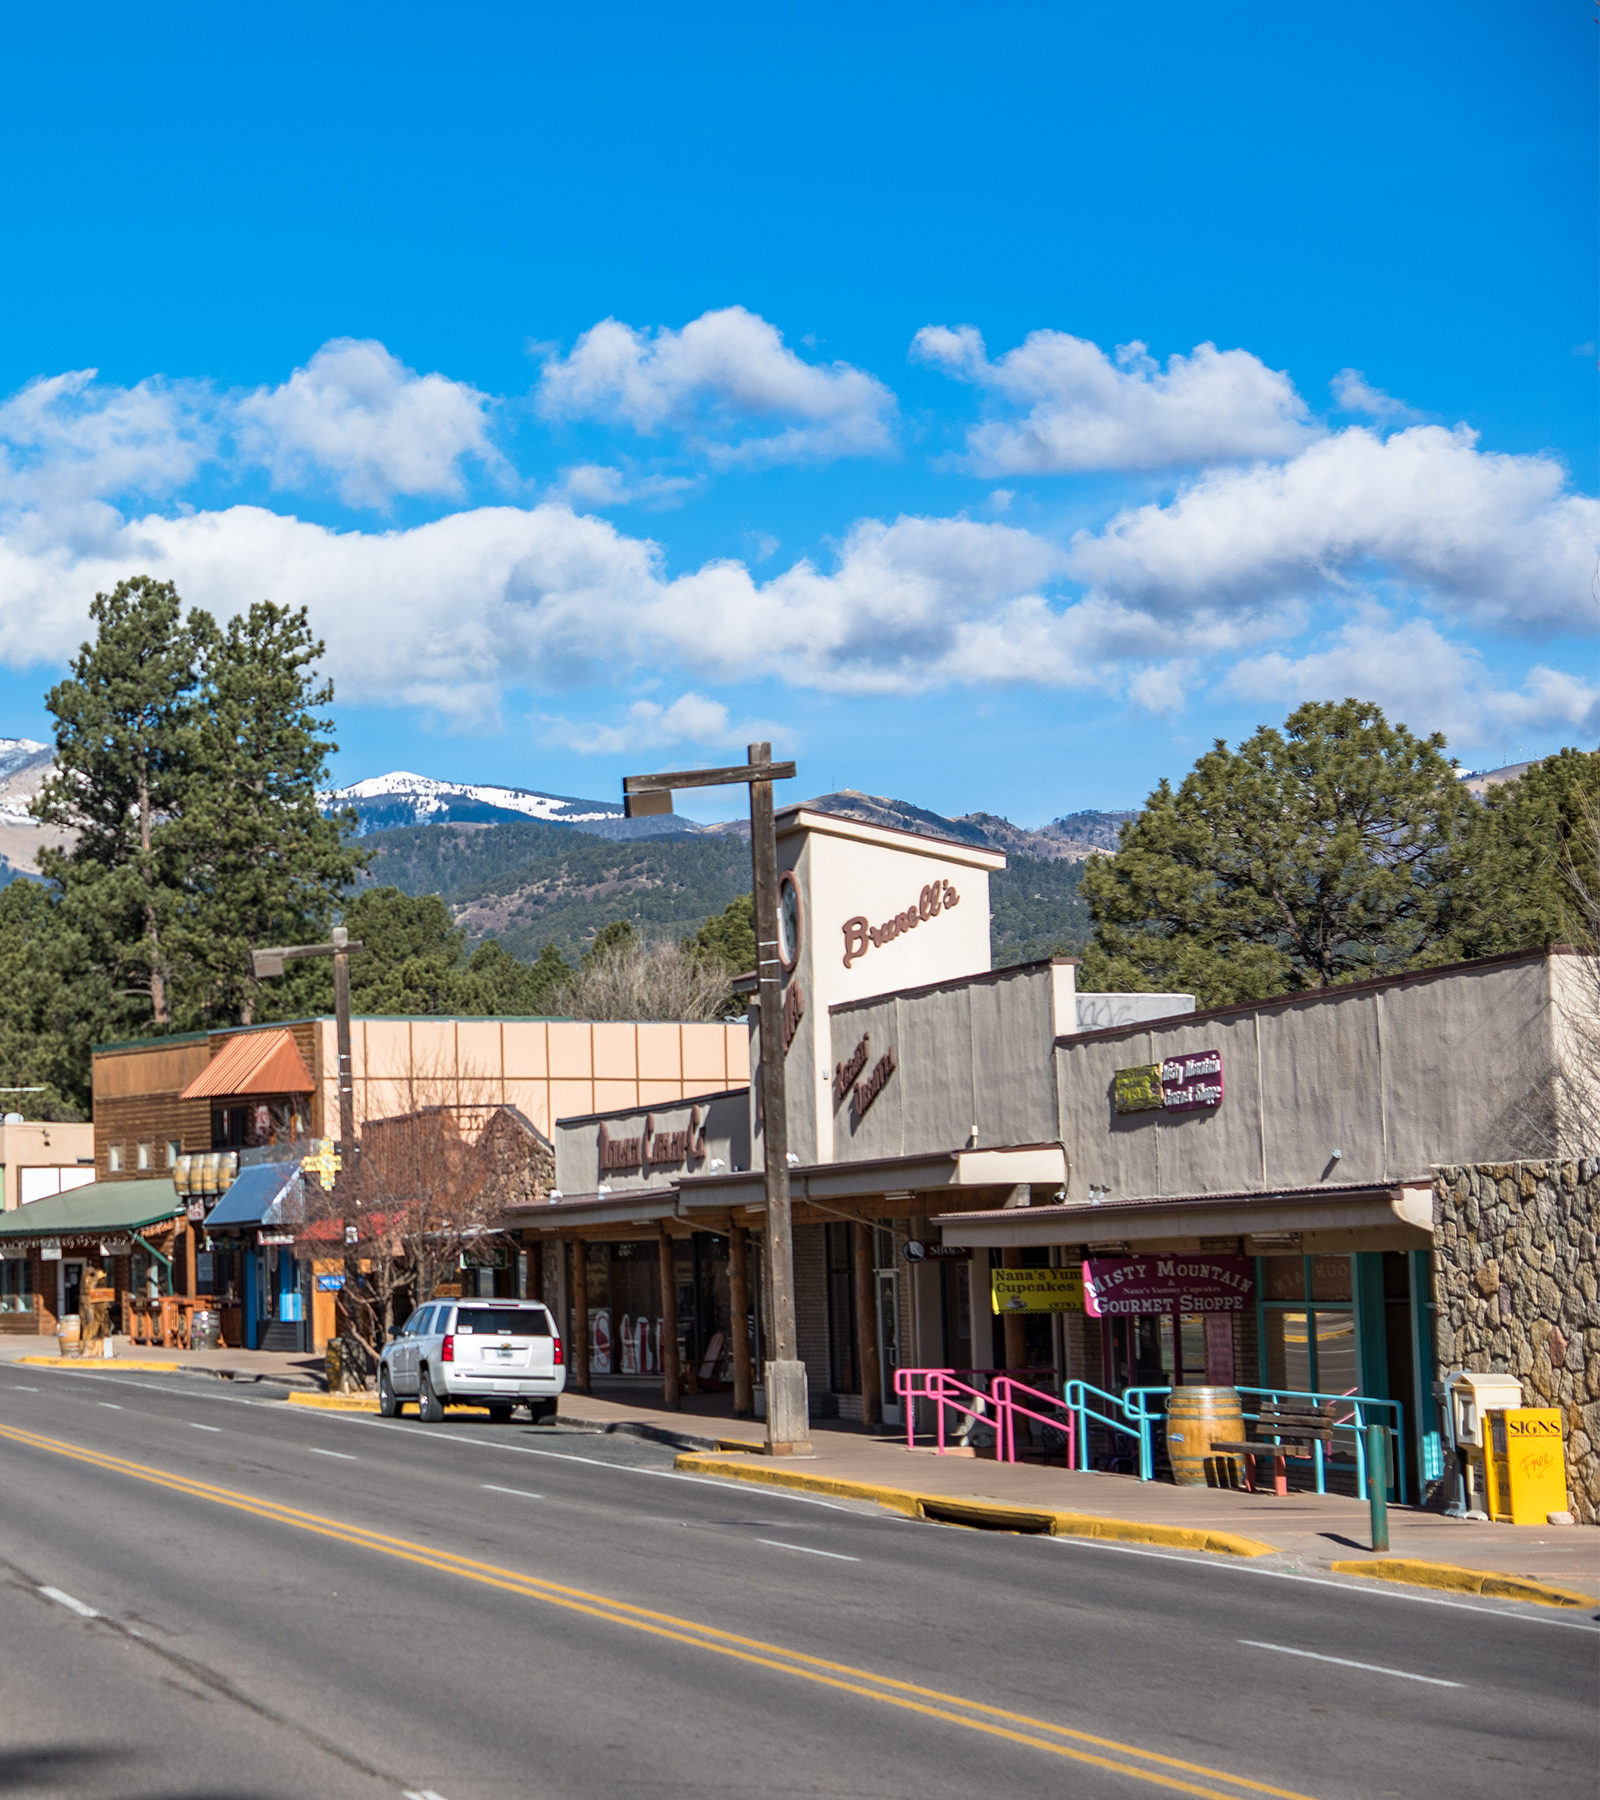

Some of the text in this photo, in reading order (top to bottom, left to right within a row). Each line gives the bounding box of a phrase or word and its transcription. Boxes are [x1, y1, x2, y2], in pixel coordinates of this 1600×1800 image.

[842, 879, 960, 969] Brunell's
[995, 1270, 1046, 1281] Nana's
[1084, 1260, 1253, 1298] MISTY MOUNTAIN
[996, 1282, 1075, 1294] Cupcakes
[1123, 1285, 1221, 1295] Nana's Yummy Cupcakes
[1093, 1294, 1243, 1314] GOURMET SHOPPE
[1510, 1419, 1561, 1434] SIGNS
[1519, 1452, 1555, 1479] Free
